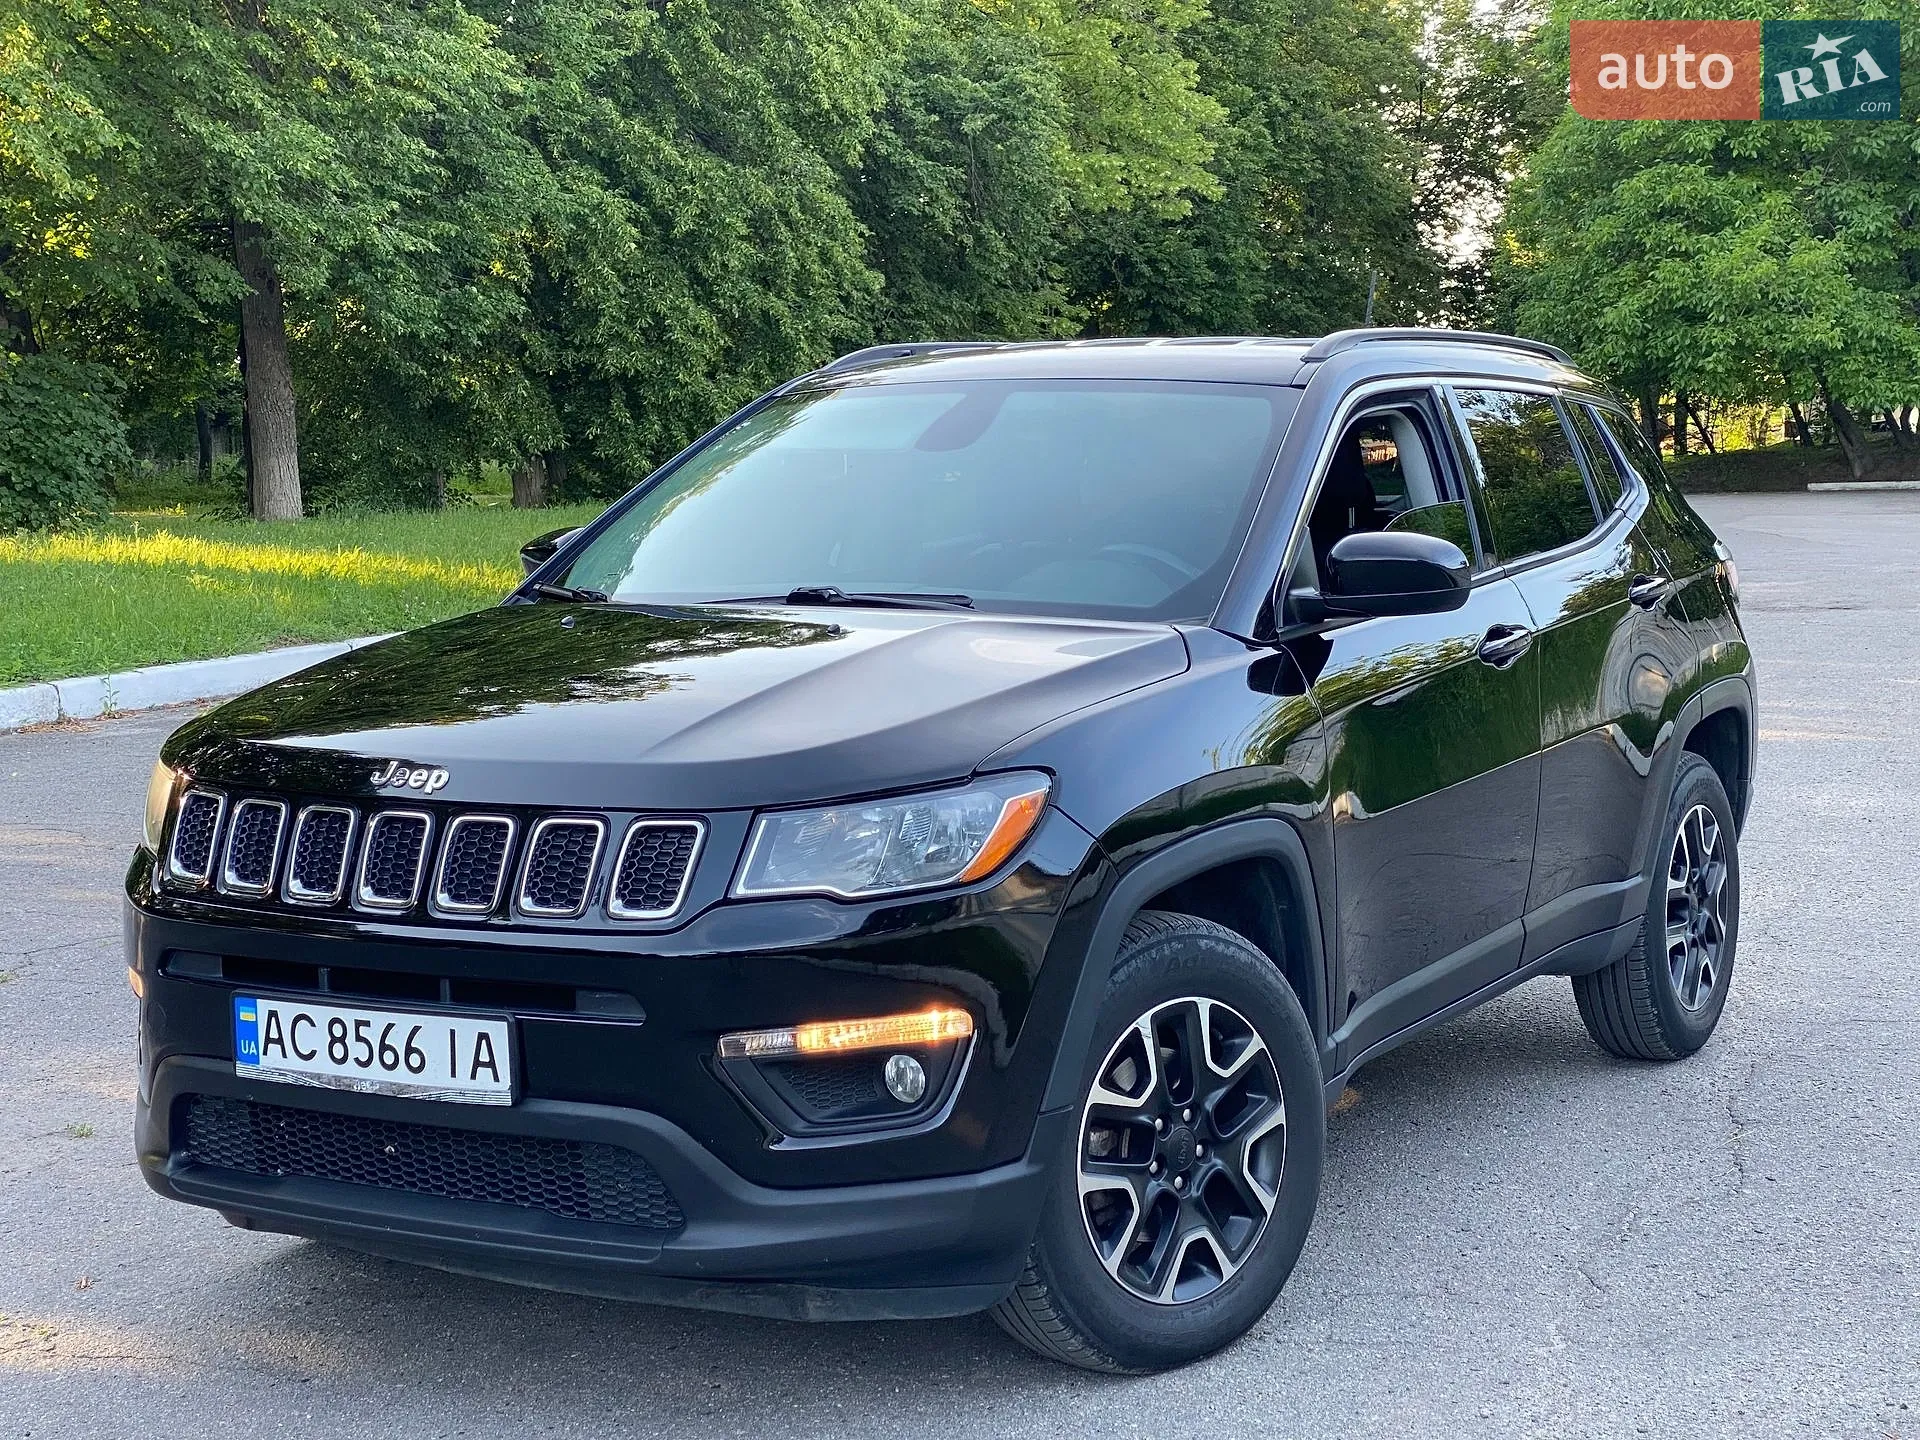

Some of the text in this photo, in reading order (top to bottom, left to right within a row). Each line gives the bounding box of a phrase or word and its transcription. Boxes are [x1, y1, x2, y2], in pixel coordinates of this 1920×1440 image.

[370, 760, 450, 795] Jeep
[241, 1039, 258, 1056] UA
[262, 1009, 500, 1083] AC 8566 IA
